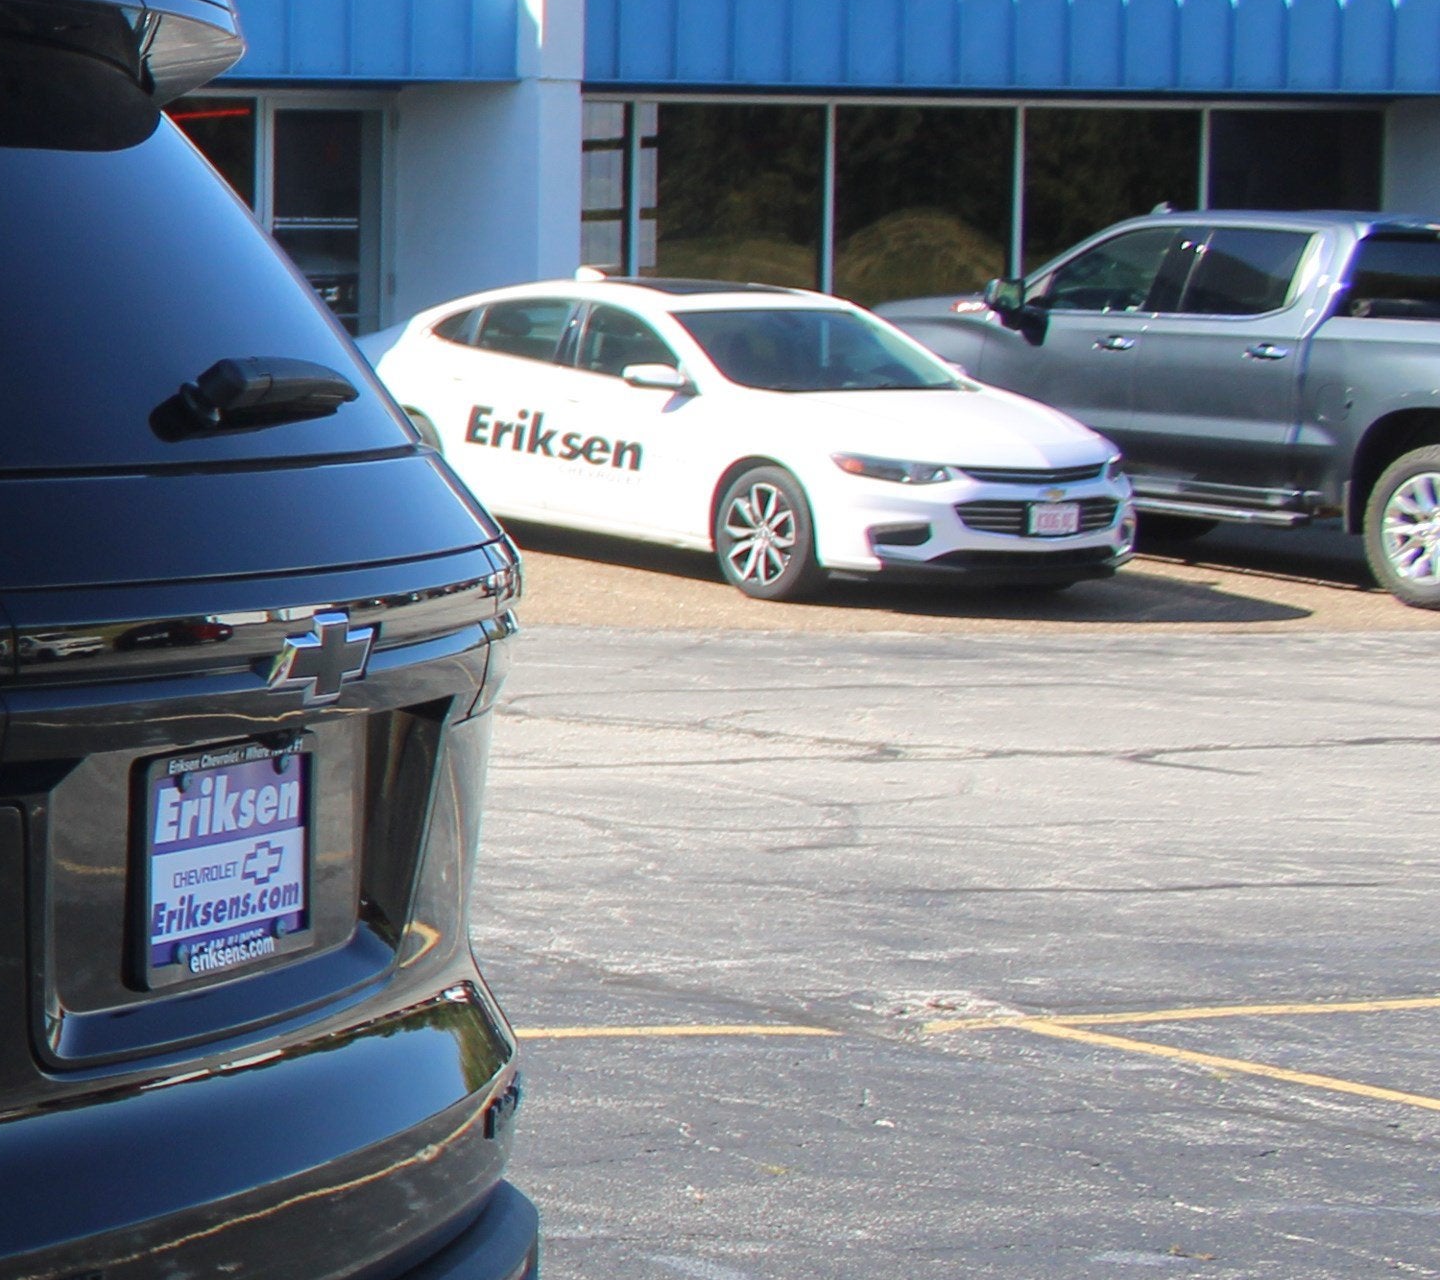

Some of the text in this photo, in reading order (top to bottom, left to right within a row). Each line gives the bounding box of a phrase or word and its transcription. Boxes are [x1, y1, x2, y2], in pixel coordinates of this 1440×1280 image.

[464, 404, 644, 472] Eriksen
[167, 758, 200, 775] Eriksen
[201, 749, 240, 769] Chevrolet
[153, 775, 301, 846] Eriksen
[173, 861, 238, 889] CHEVROLET
[152, 882, 300, 937] Eriksens.com
[189, 936, 276, 974] eriksens.com
